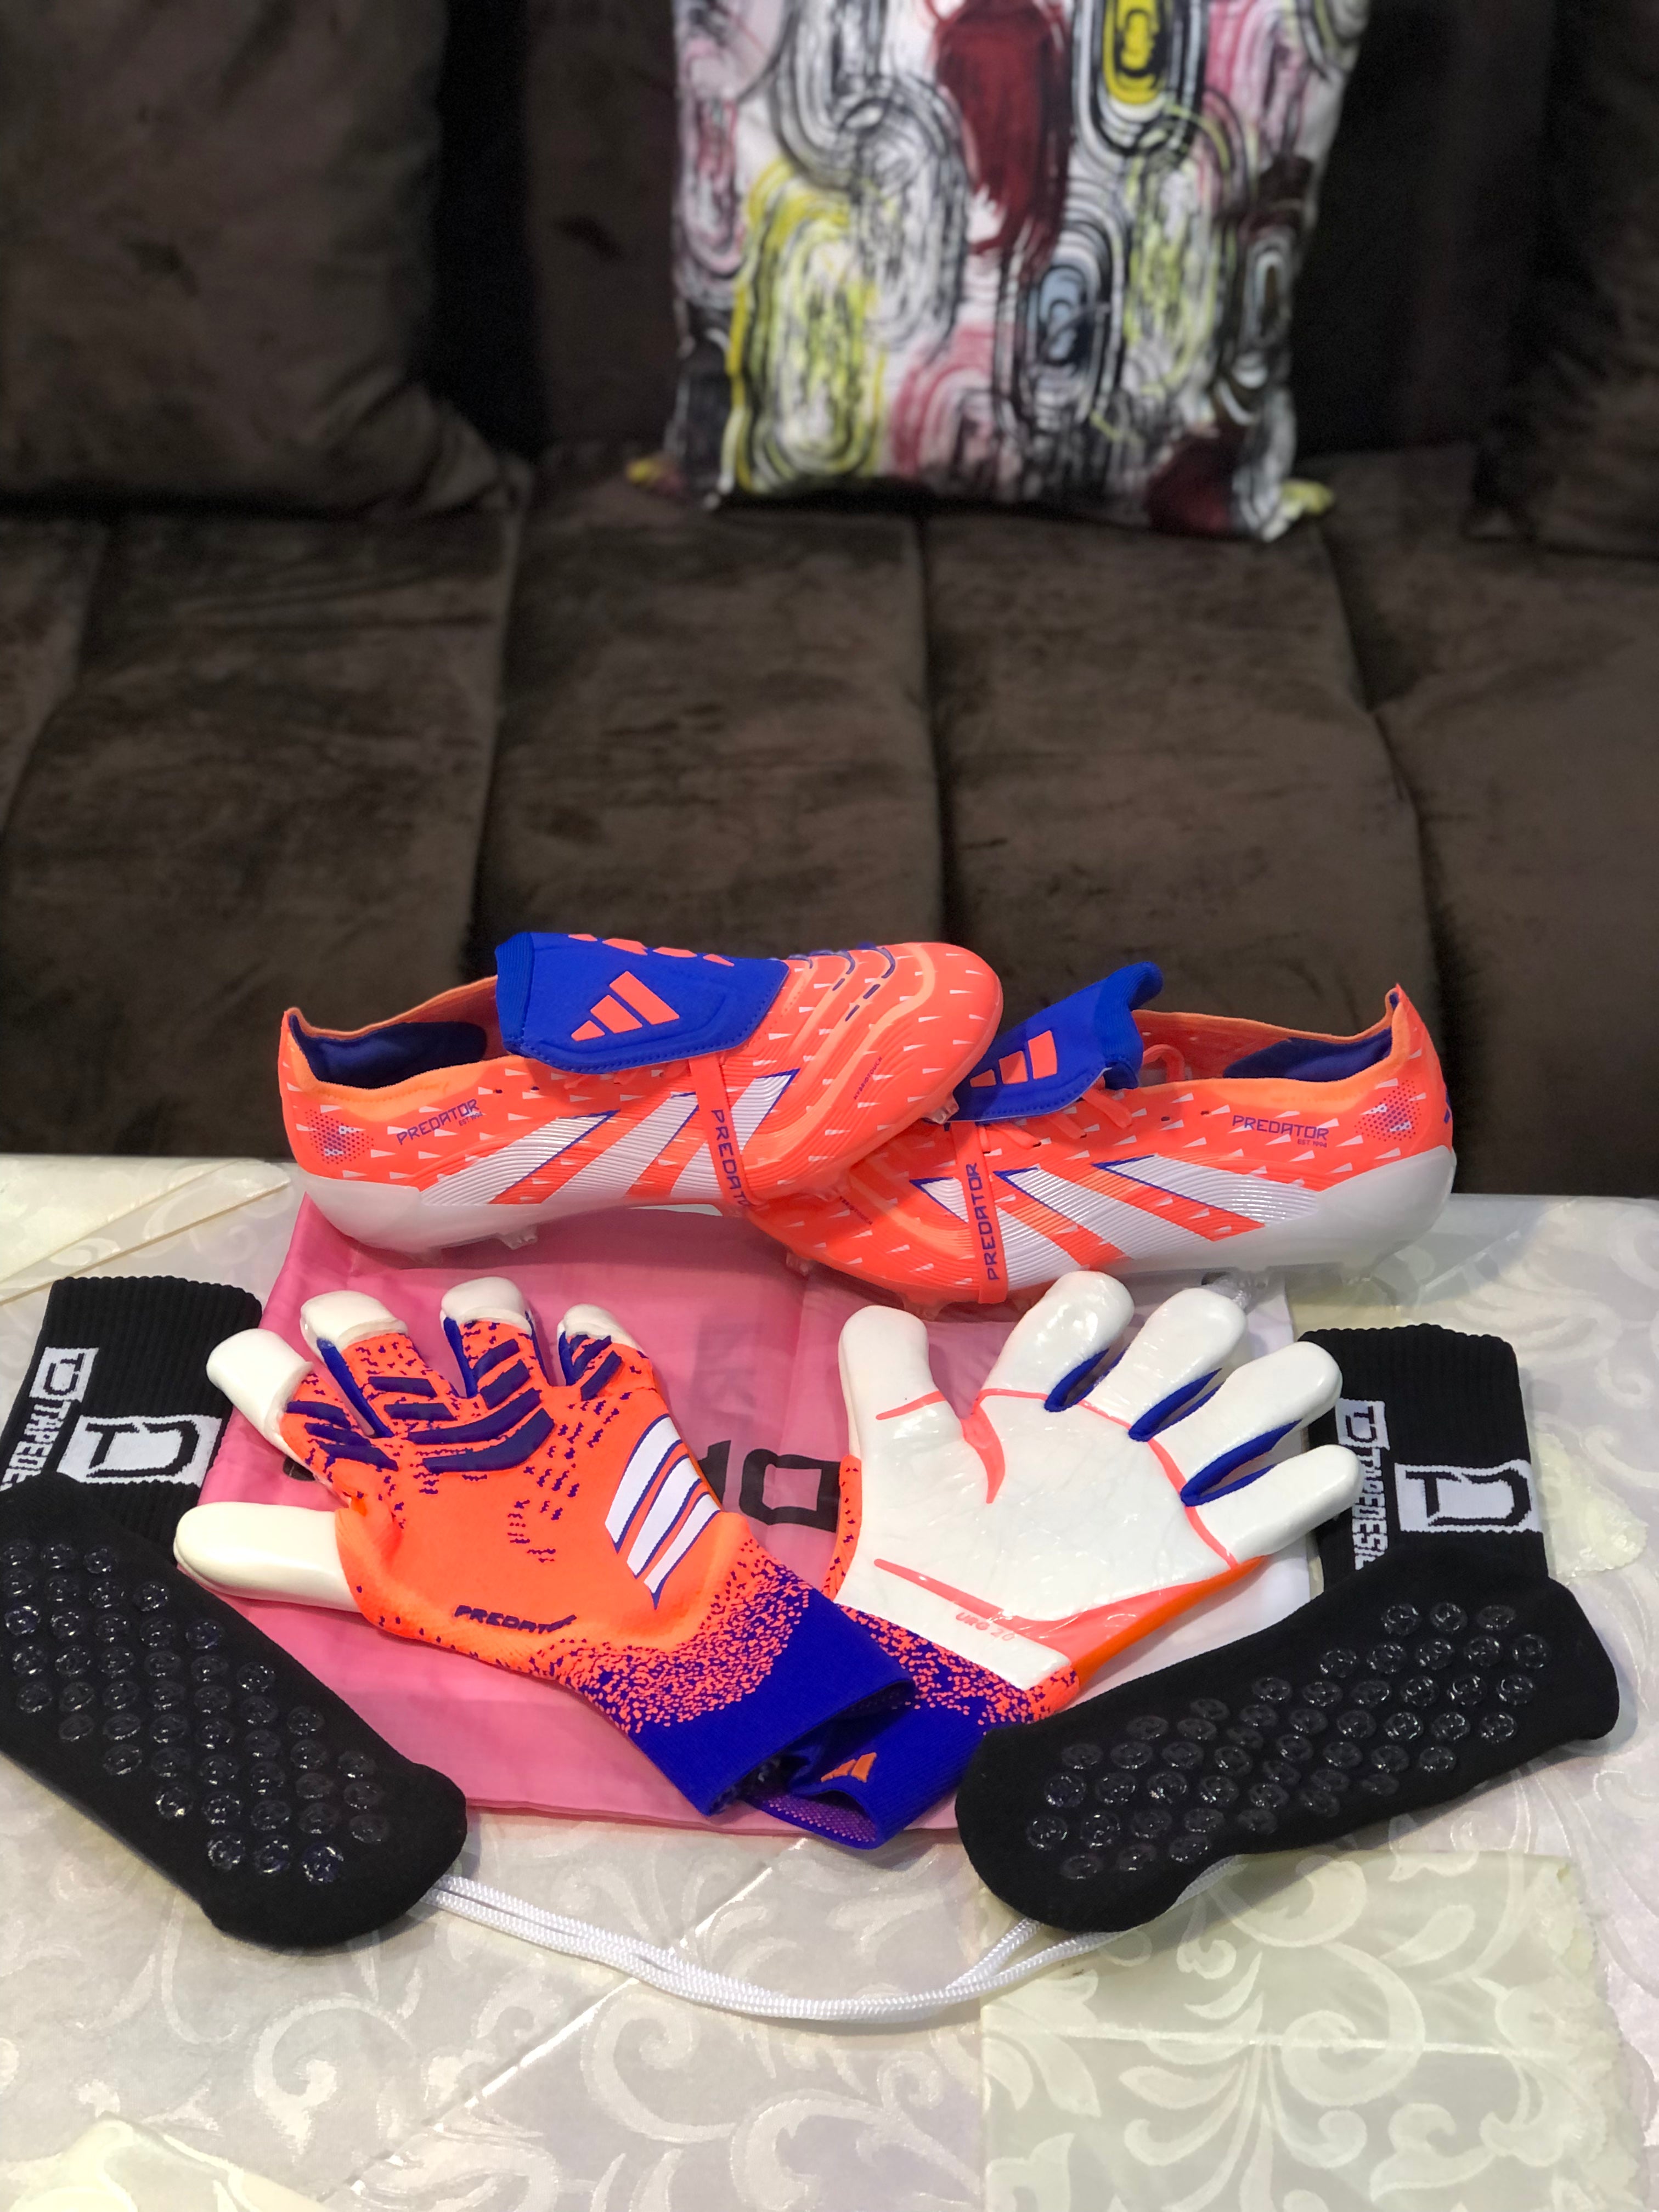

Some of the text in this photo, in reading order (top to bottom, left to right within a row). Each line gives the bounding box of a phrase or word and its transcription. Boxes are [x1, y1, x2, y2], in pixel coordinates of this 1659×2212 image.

[396, 1098, 480, 1146] PREDATOR
[1232, 1114, 1329, 1141] PREDATOR
[966, 1162, 1000, 1280] PREDATOR
[0, 1400, 72, 1492] TAPEDE
